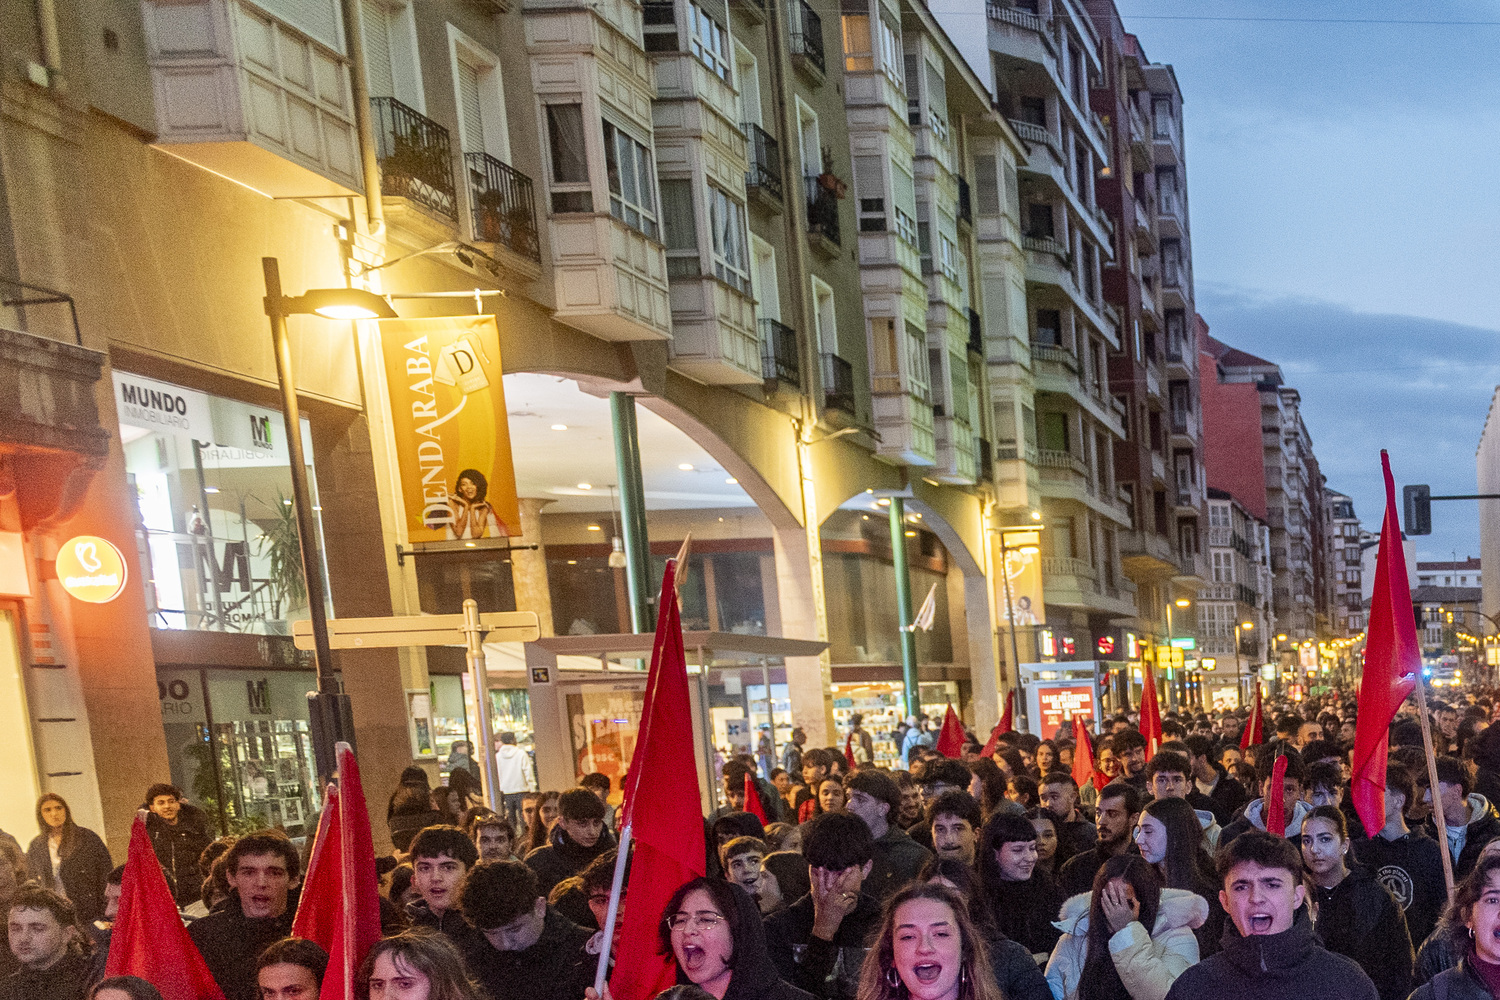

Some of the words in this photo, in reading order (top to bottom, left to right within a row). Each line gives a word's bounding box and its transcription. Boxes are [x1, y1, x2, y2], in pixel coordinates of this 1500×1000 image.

[122, 383, 187, 416] MUNDO
[125, 406, 190, 430] INMOBILIARIO
[403, 335, 457, 527] DENDARABA
